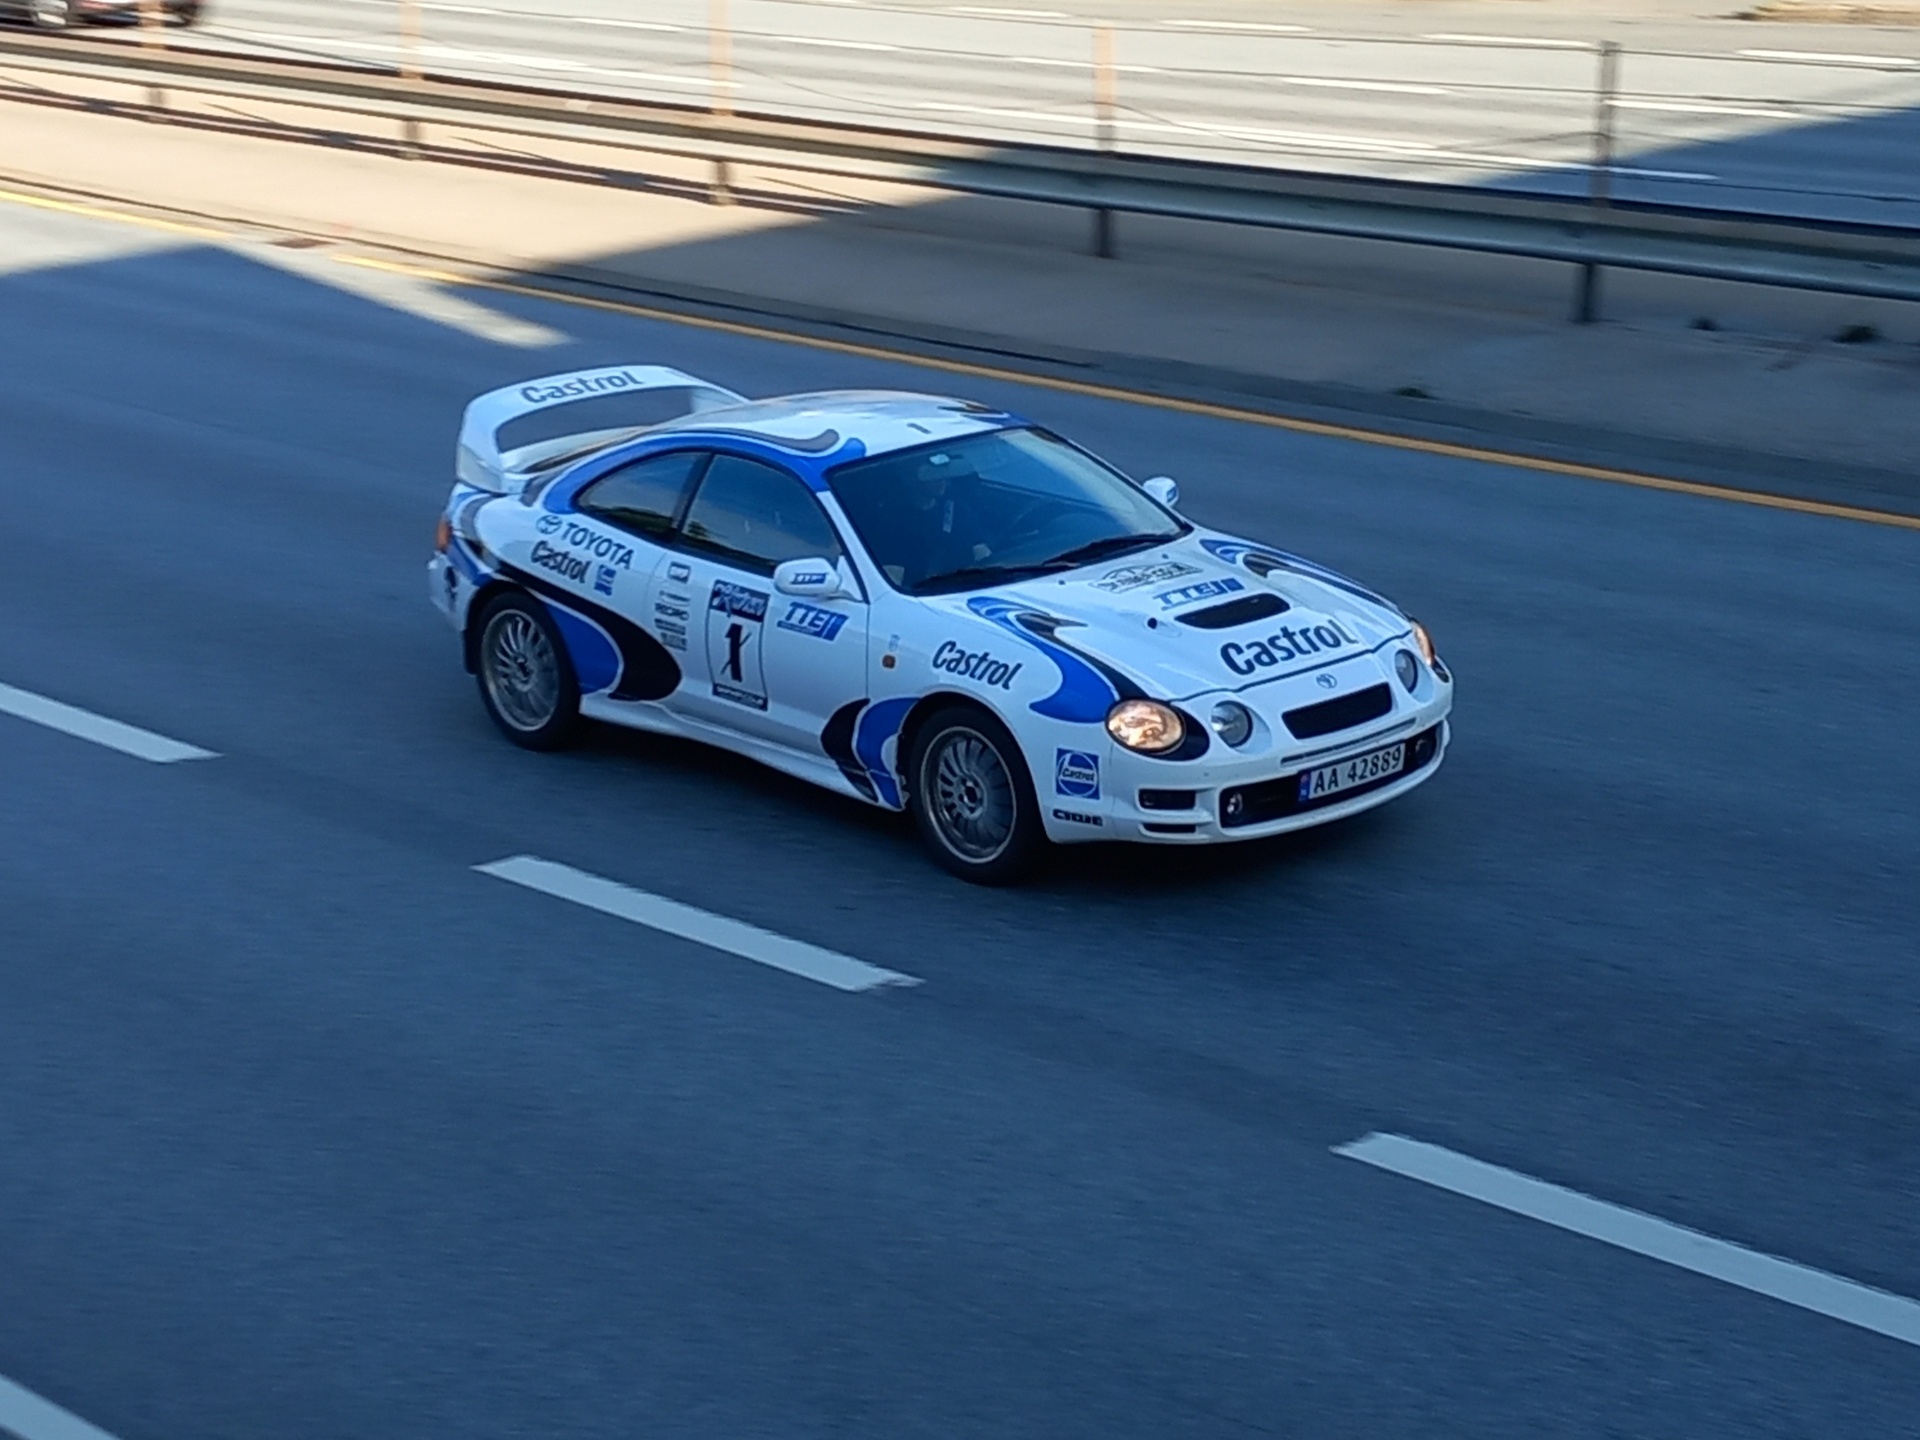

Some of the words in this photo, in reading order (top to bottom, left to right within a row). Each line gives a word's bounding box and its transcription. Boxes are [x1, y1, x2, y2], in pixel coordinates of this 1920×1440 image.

[521, 371, 645, 403] Castrol
[530, 540, 592, 584] Castrol
[561, 522, 634, 570] TOYOTA
[725, 622, 743, 683] 1
[932, 640, 1023, 690] Castrol
[1220, 619, 1360, 675] Castrol
[1061, 767, 1095, 782] Castrol
[1313, 767, 1339, 795] AA
[1347, 745, 1401, 783] 42889
